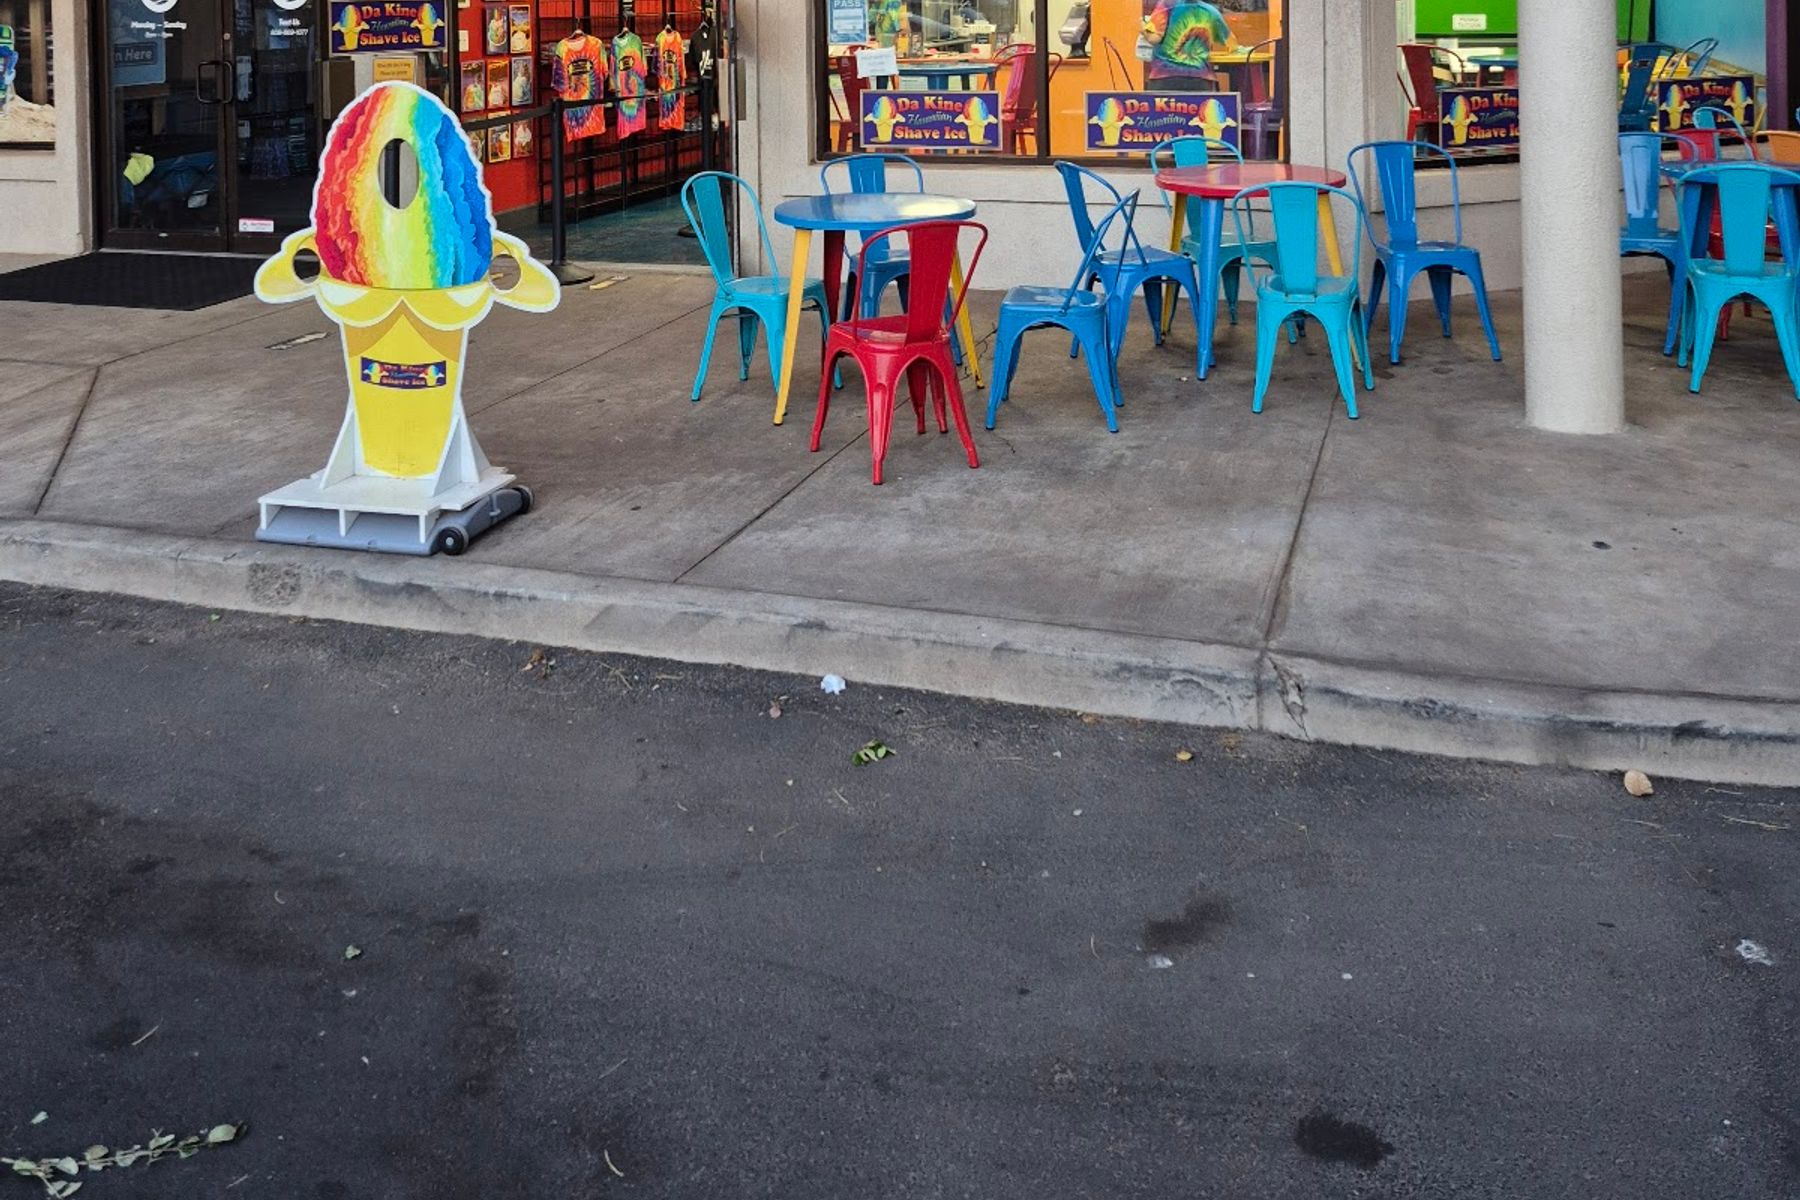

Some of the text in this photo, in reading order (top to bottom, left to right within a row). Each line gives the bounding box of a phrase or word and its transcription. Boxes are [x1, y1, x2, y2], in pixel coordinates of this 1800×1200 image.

[361, 3, 417, 19] Da Kine
[834, 0, 861, 8] PASS
[360, 31, 420, 45] Shave Ice
[125, 49, 153, 61] Here
[897, 96, 963, 112] Da Kine
[1124, 97, 1198, 114] Da Kine
[1470, 93, 1518, 111] Da Kin
[894, 125, 967, 140] Shave Ice
[1122, 128, 1172, 143] Shave
[1469, 126, 1507, 139] Shave
